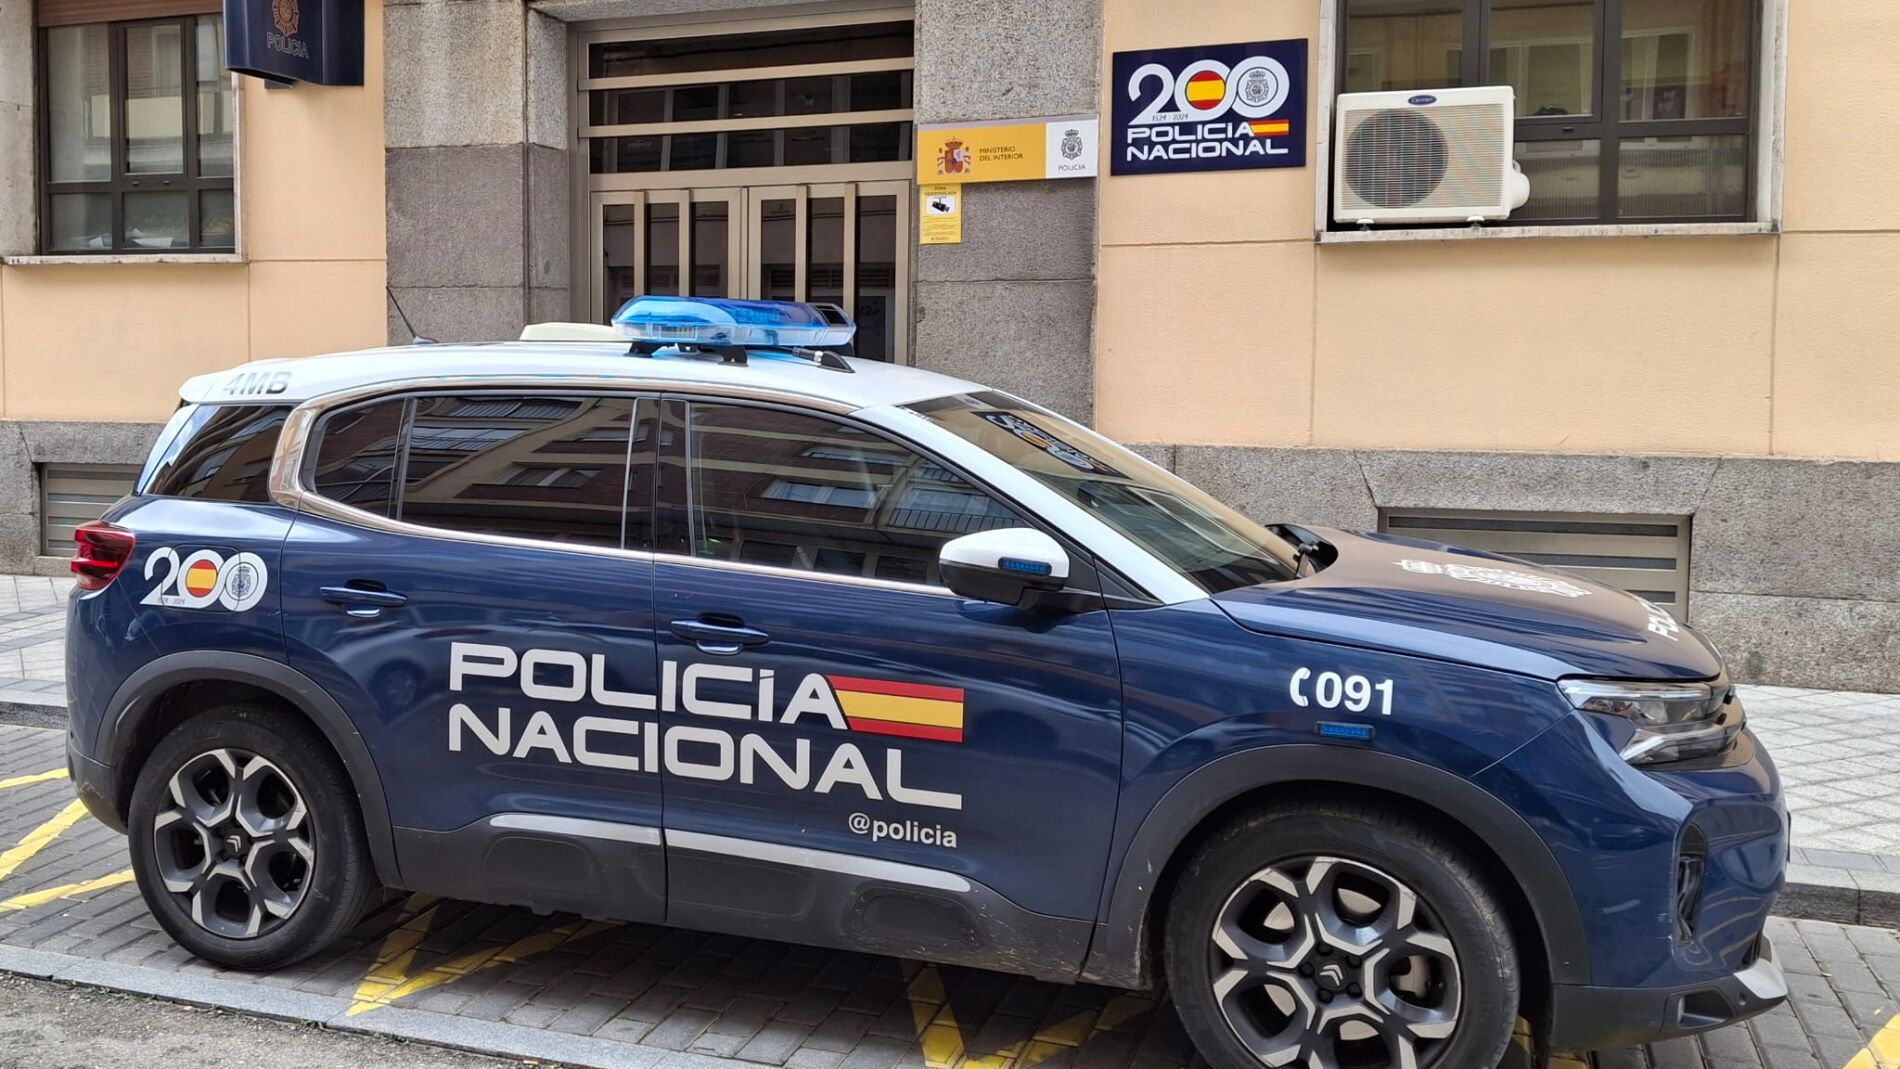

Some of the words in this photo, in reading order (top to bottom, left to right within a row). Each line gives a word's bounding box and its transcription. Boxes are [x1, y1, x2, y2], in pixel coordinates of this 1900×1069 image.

[1128, 55, 1290, 126] 200
[979, 146, 1016, 154] MINISTERIO
[979, 154, 992, 162] DEL
[993, 153, 1023, 161] INTERIOR
[1126, 138, 1289, 162] NACIONAL
[223, 371, 292, 395] 4MB
[139, 546, 268, 612] 200
[1315, 670, 1395, 716] 091
[448, 703, 962, 810] NACIONAL
[848, 812, 957, 848] @policia
